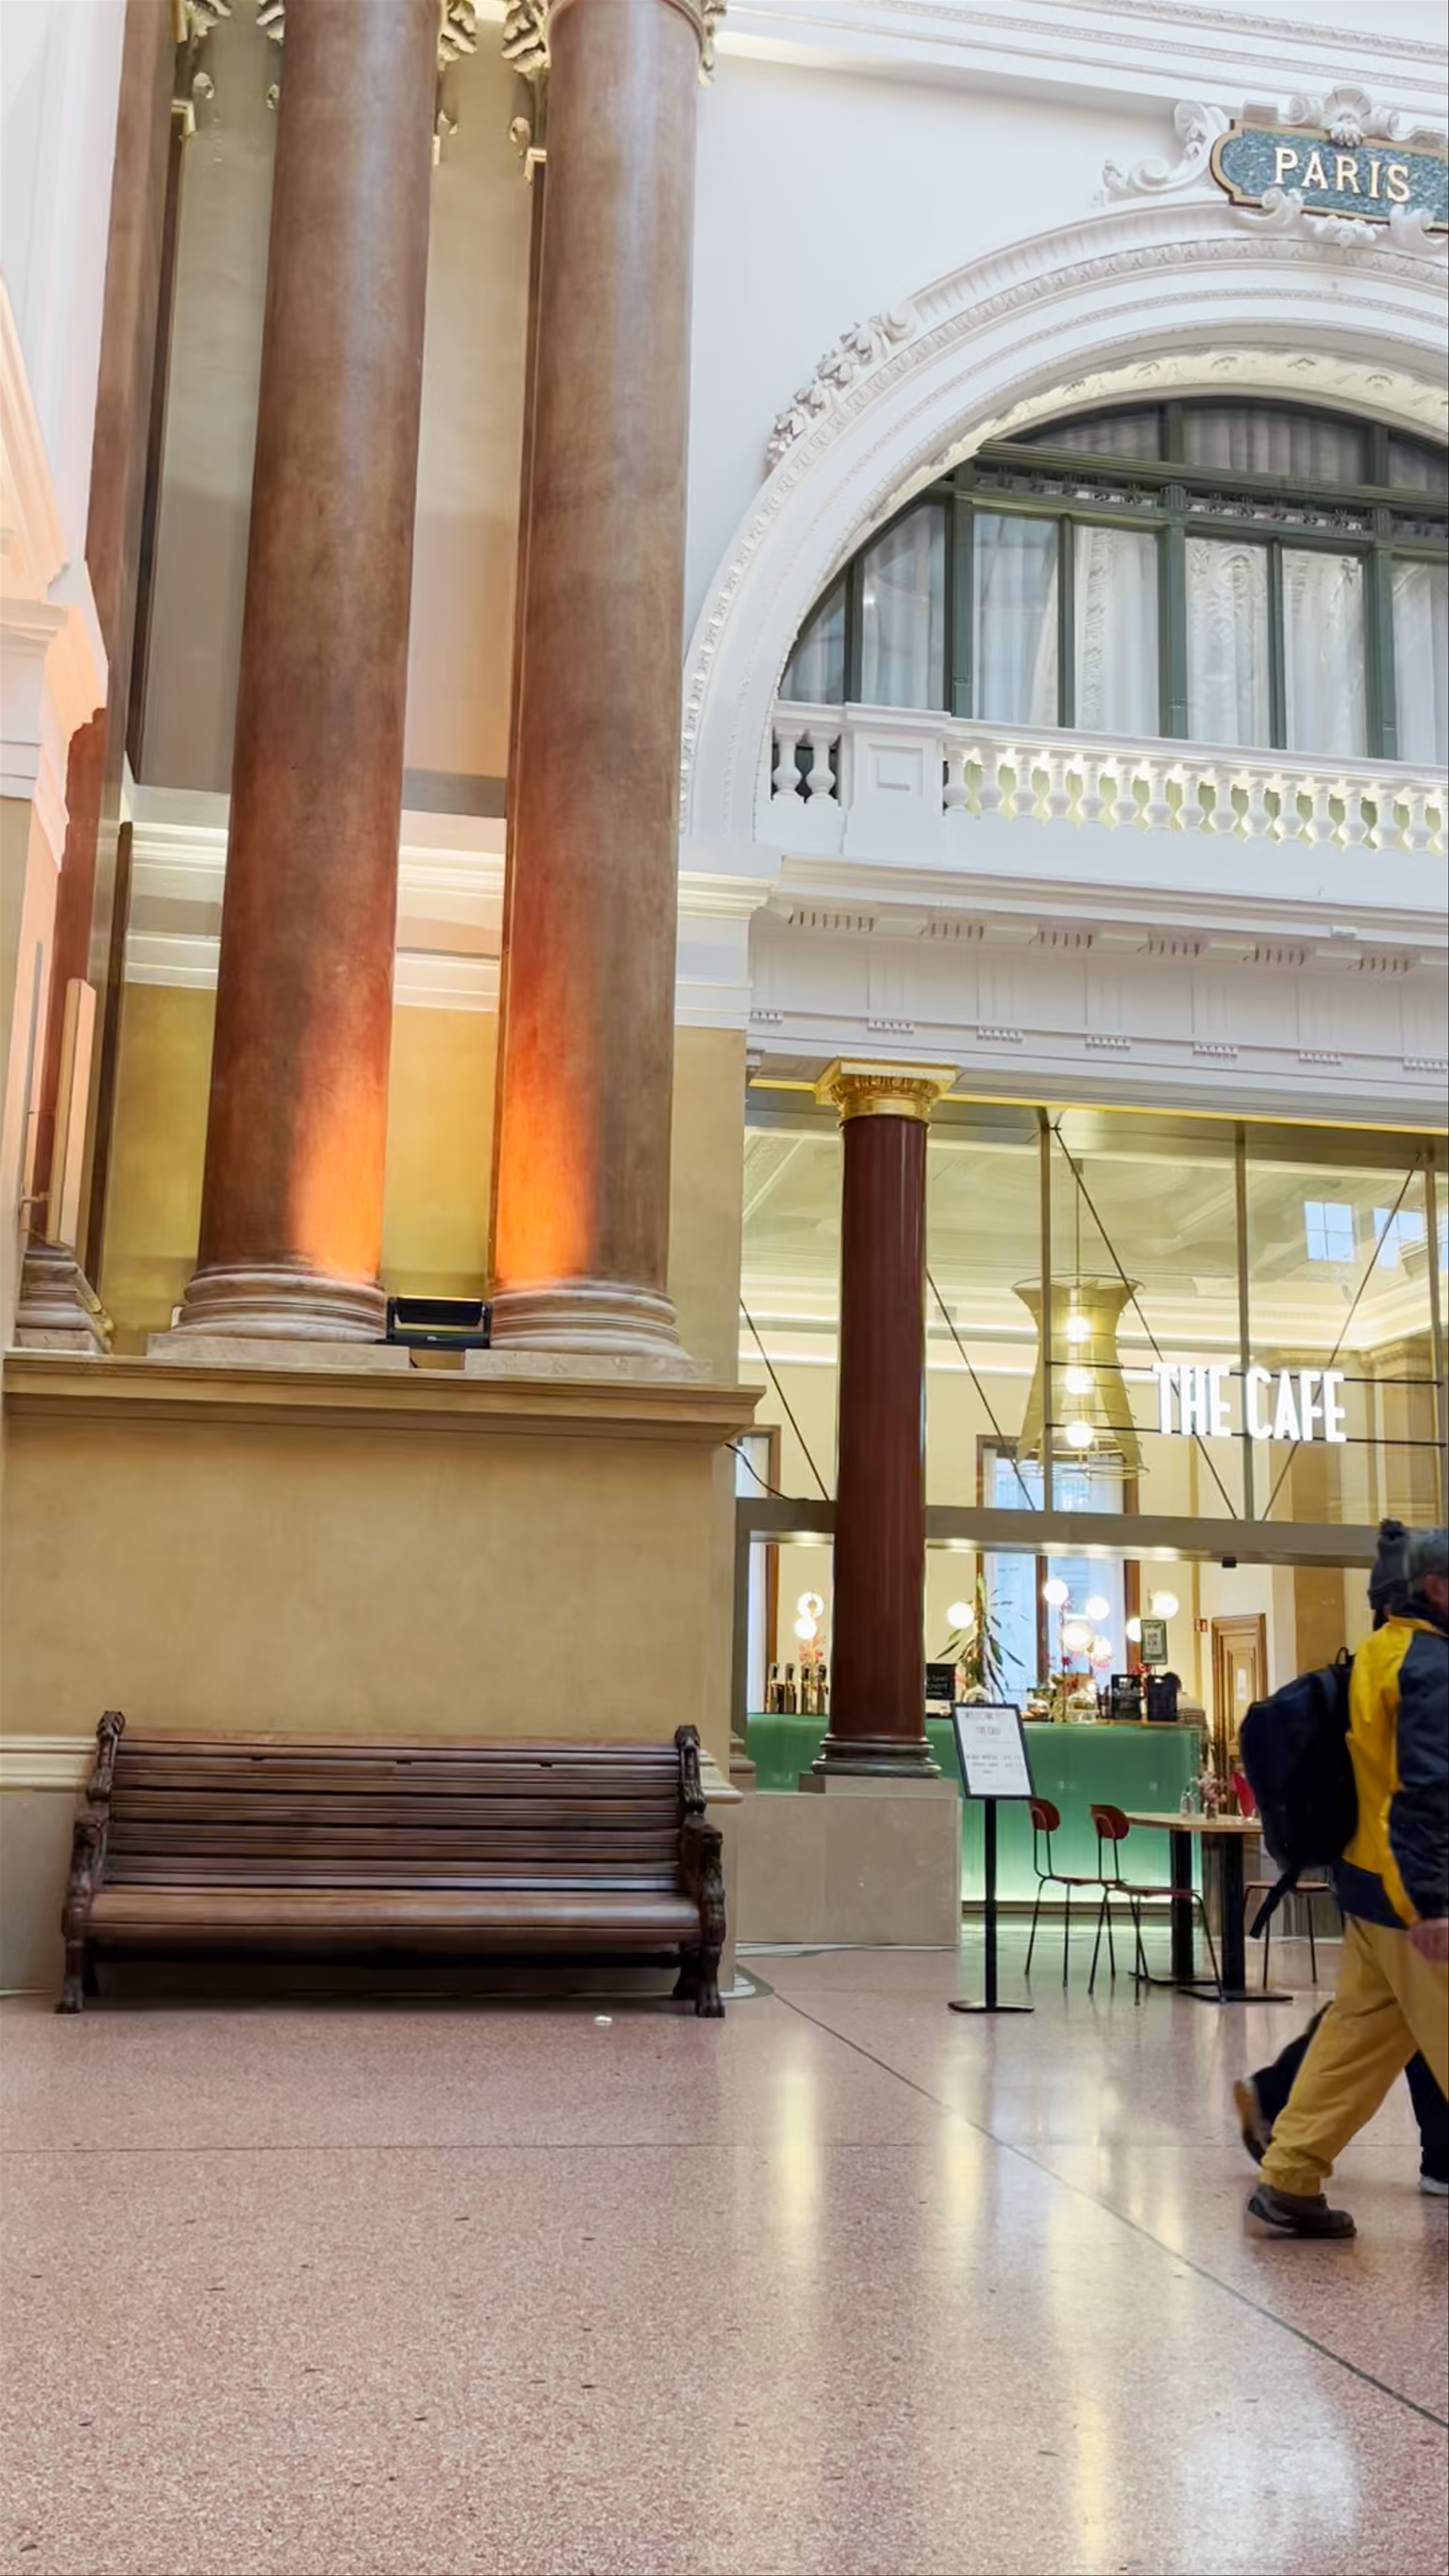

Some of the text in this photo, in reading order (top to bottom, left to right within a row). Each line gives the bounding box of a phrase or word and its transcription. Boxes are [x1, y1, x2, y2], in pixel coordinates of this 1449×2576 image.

[1275, 148, 1411, 203] PARIS
[1152, 1363, 1347, 1442] THE CAFE
